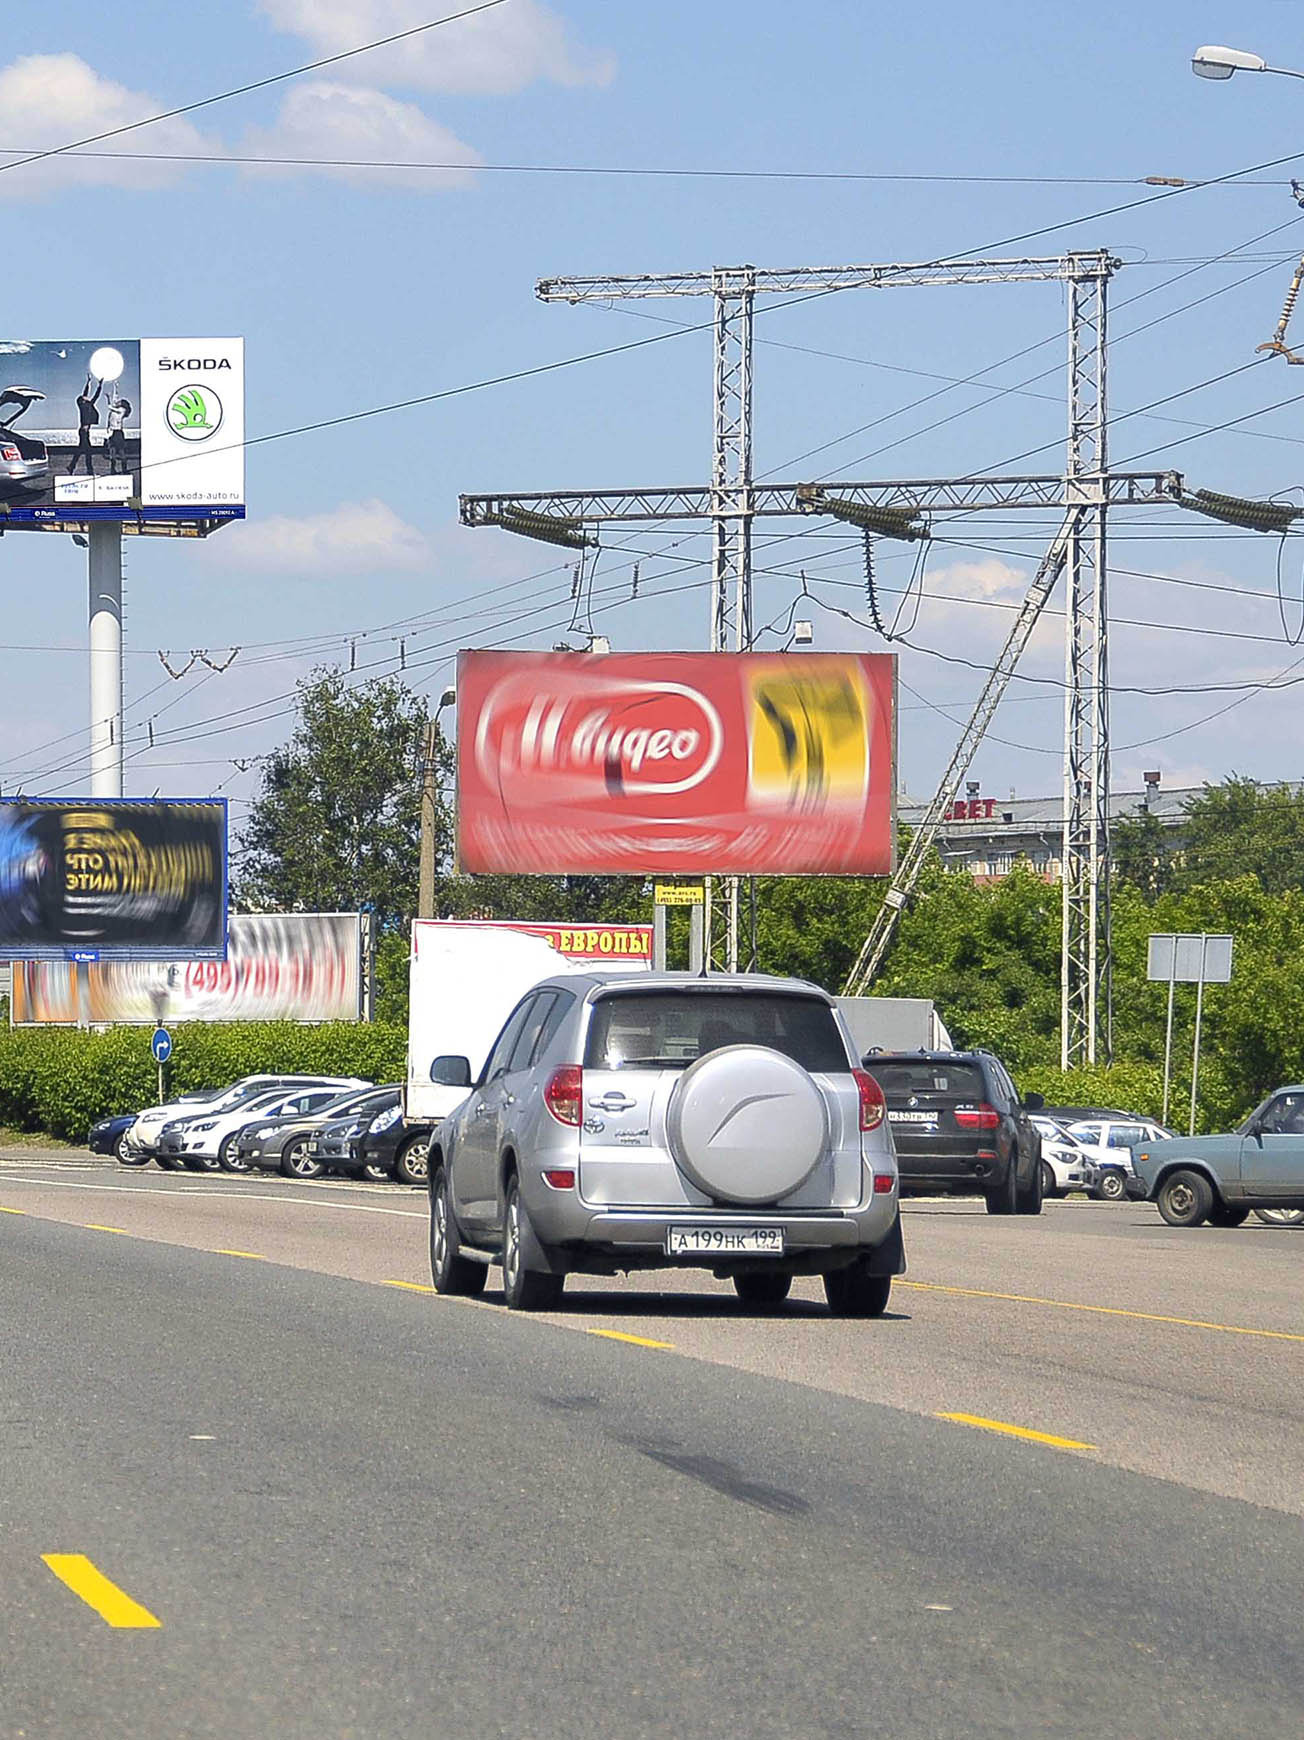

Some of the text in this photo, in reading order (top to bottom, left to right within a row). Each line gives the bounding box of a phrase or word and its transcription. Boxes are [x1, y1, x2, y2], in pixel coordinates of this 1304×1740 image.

[158, 356, 232, 371] ŠKODA
[944, 798, 997, 821] ВЕТ
[559, 931, 649, 954] ЕВРОПЫ
[677, 1230, 777, 1248] А199НК 199
